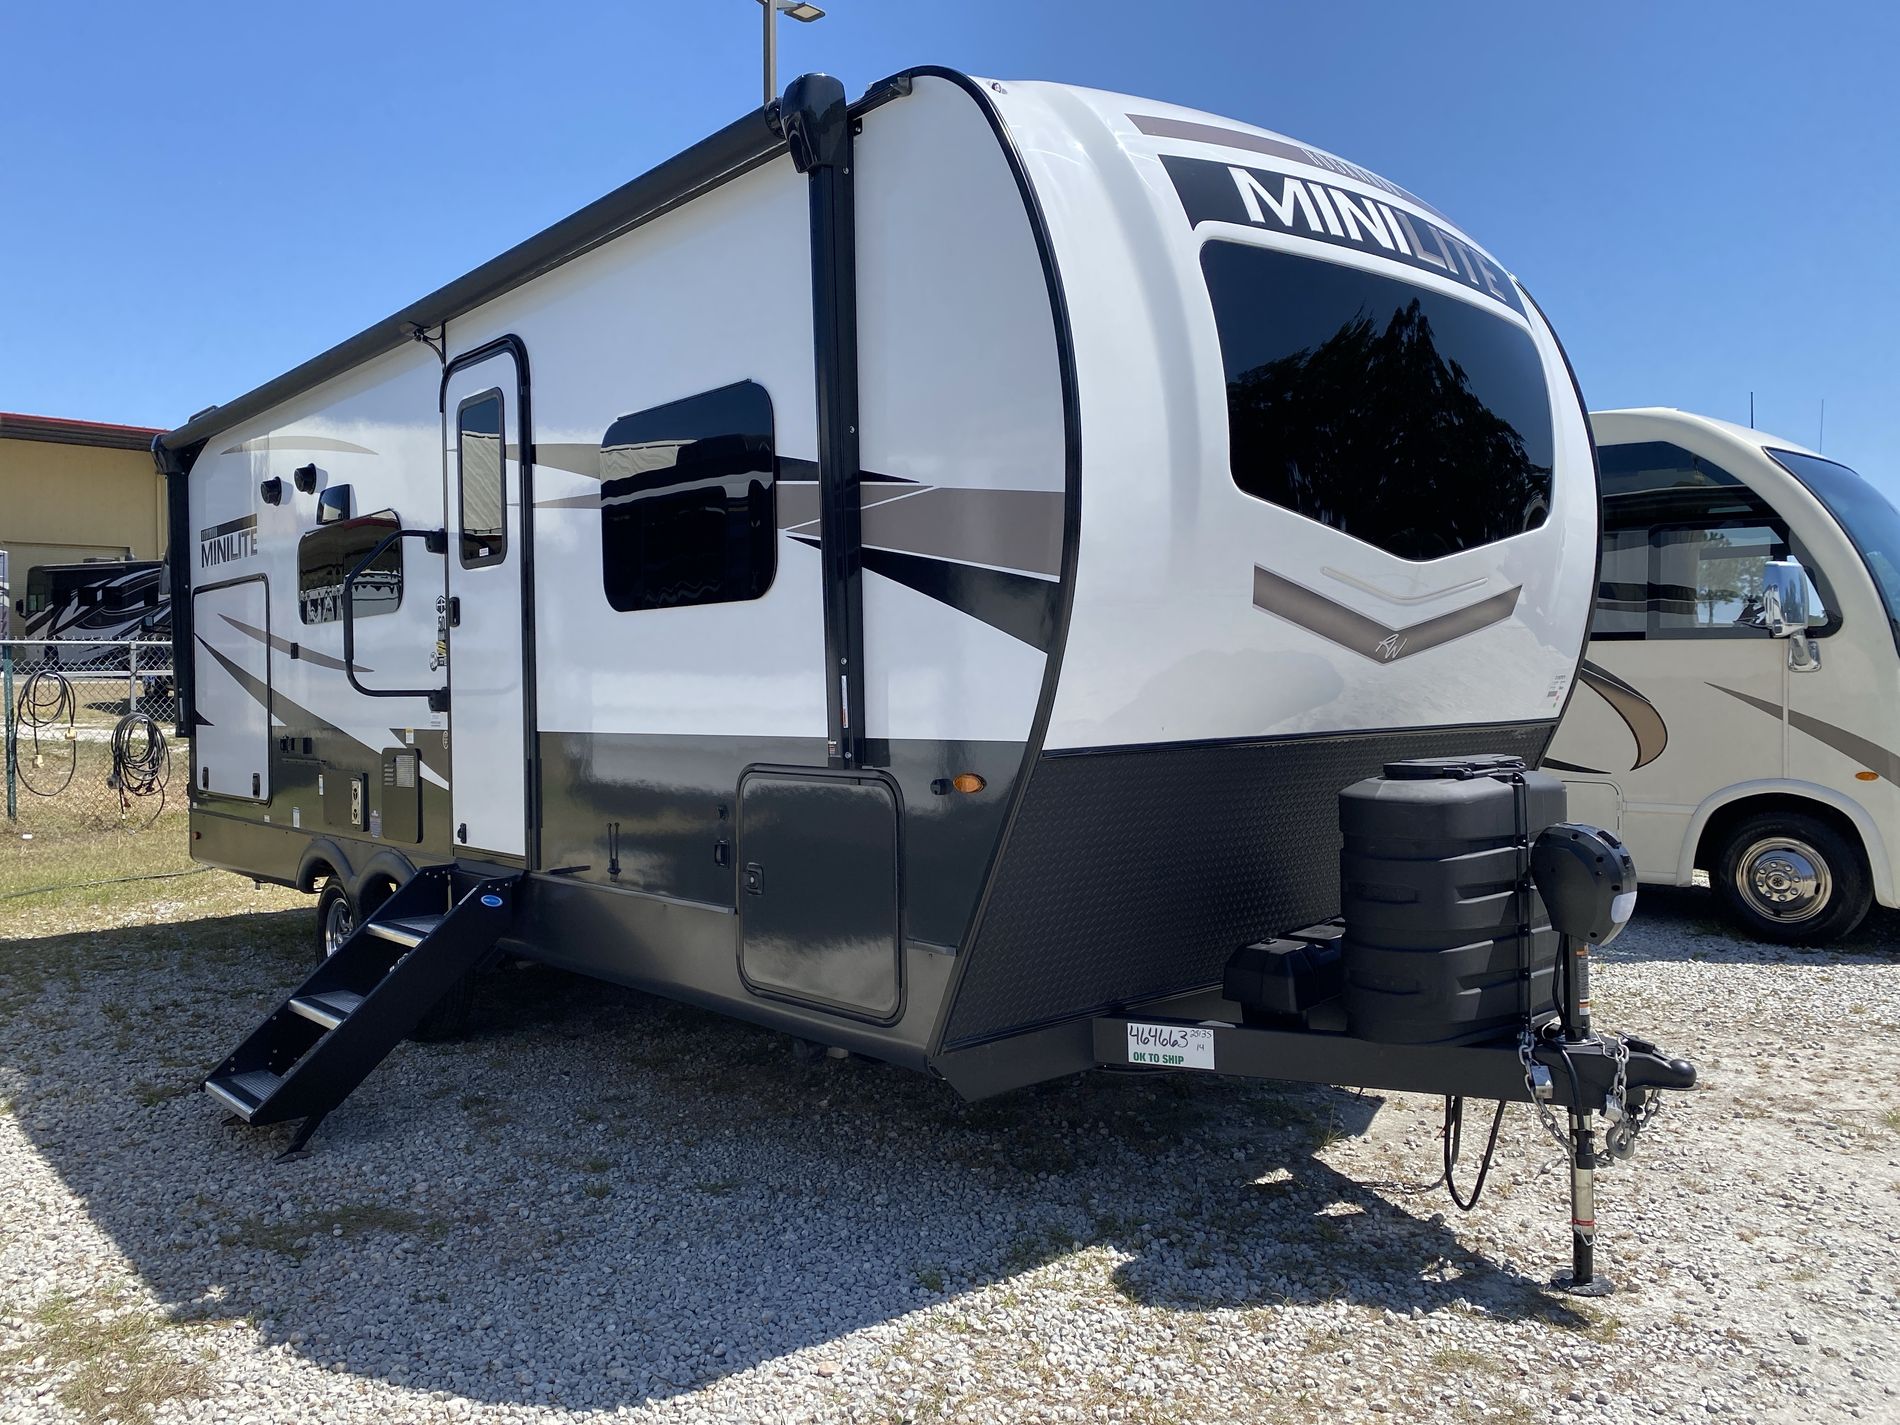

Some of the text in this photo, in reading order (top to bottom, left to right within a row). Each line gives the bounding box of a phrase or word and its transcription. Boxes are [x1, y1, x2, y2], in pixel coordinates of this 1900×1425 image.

[201, 528, 257, 568] MINILITE
[1129, 1025, 1188, 1048] 464663
[1133, 1051, 1184, 1065] OK TO SHIP
